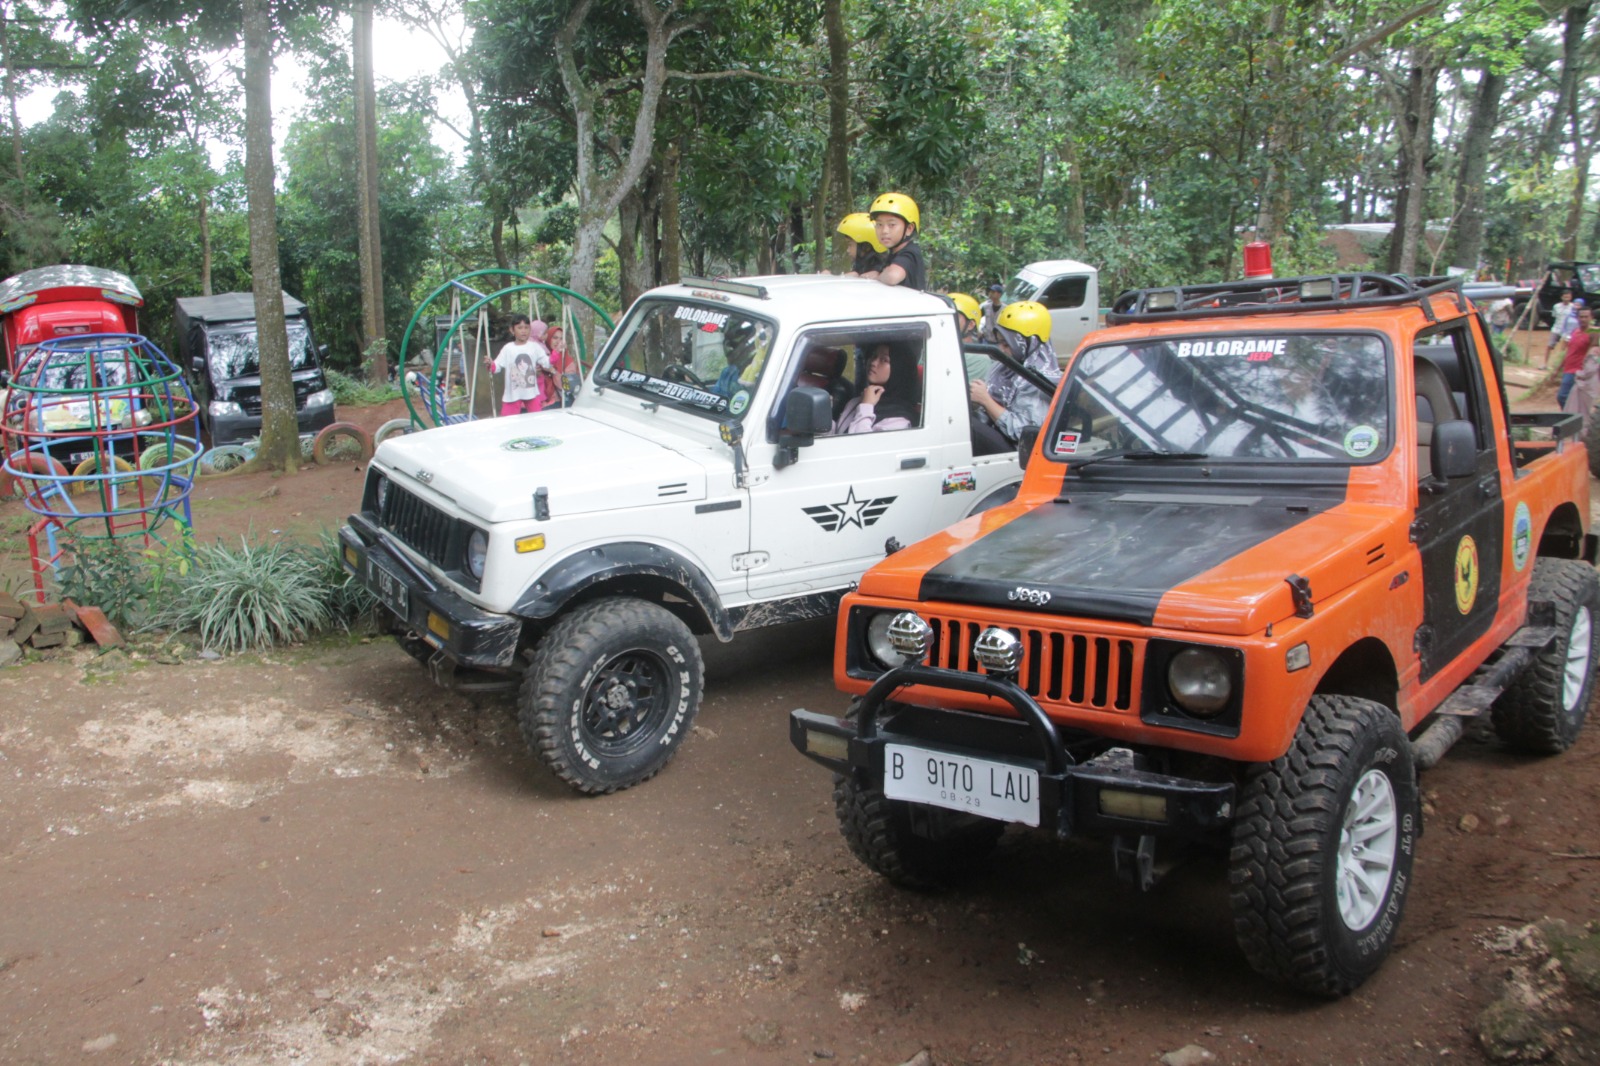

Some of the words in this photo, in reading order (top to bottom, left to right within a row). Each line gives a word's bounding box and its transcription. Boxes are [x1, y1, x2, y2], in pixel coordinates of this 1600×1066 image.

[674, 306, 728, 328] BOLORAME
[1177, 340, 1288, 358] BOLORAME
[1247, 352, 1273, 362] JEEP
[1007, 586, 1051, 606] Jeep
[666, 645, 686, 664] GT
[659, 670, 691, 745] RADIAL
[570, 700, 600, 770] SAVERO
[892, 752, 904, 780] B
[927, 758, 973, 792] 9170
[990, 768, 1031, 803] LAU
